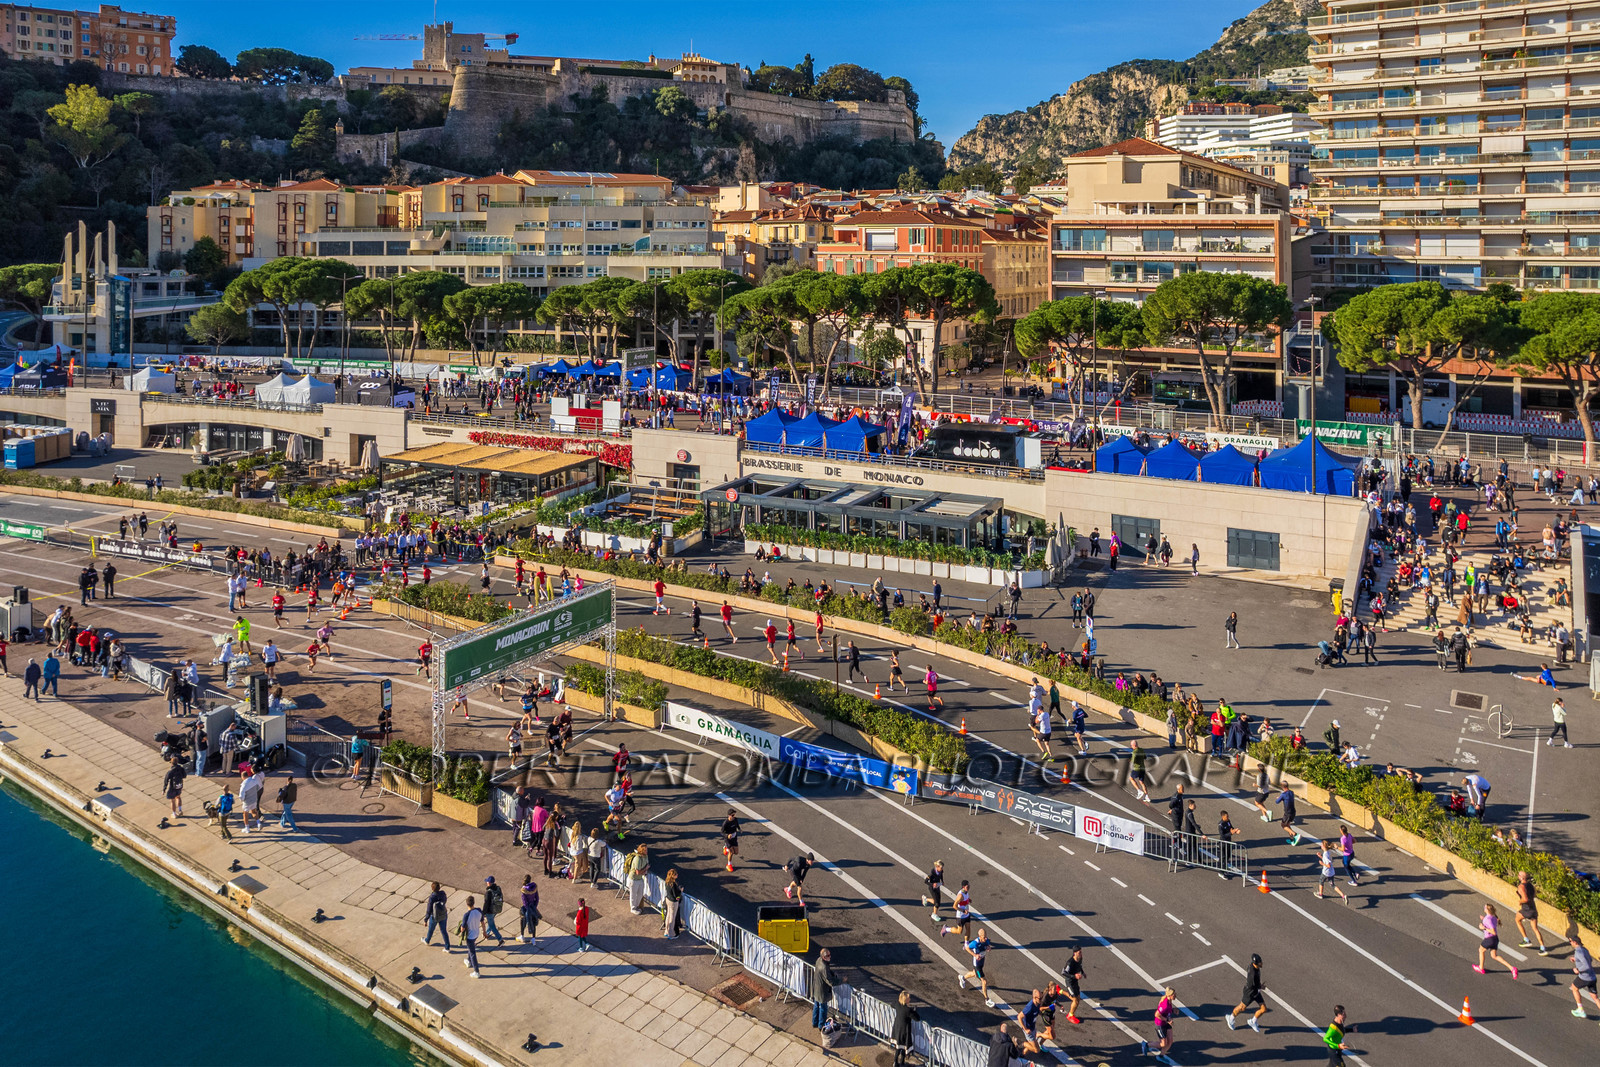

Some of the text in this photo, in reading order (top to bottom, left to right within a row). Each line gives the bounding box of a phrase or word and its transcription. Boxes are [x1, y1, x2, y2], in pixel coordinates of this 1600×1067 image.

[953, 438, 1000, 459] diadora
[1224, 436, 1274, 447] GRAMAGLIA
[742, 457, 925, 486] BRASSERIE DE MONACO
[495, 619, 551, 652] MONACORUN
[697, 718, 772, 750] GRAMAGLIA
[785, 744, 817, 763] Carlo
[867, 769, 882, 777] LOCAL
[1014, 804, 1072, 826] PASSION
[1017, 796, 1074, 818] CYCLE
[1103, 823, 1121, 832] radio
[1103, 829, 1134, 842] monaco
